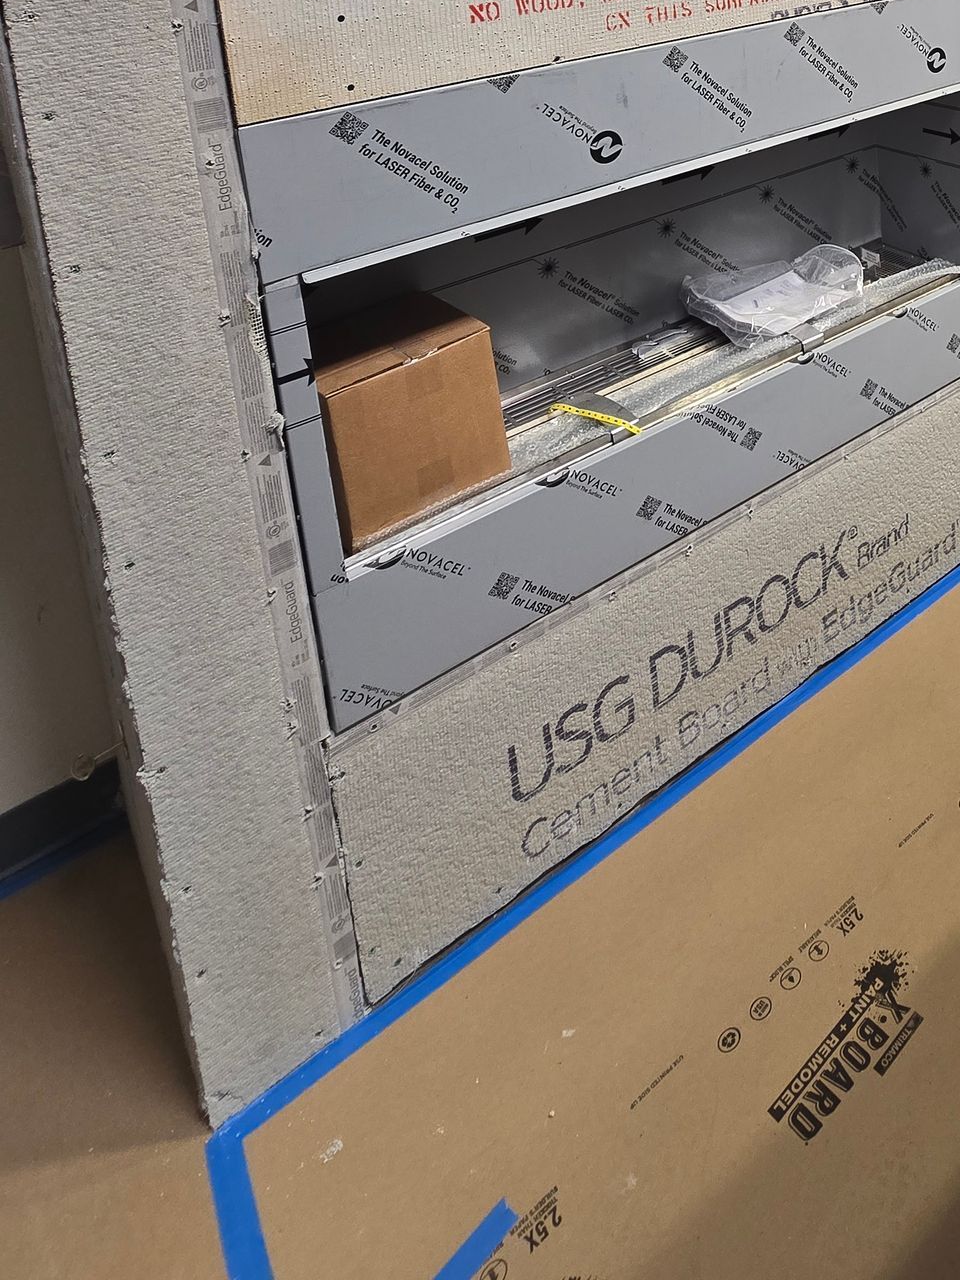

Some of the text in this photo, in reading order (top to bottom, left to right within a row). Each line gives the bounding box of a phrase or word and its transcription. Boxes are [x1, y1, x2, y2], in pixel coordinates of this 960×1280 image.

[468, 1, 500, 24] NO
[646, 0, 693, 26] THIS
[899, 23, 930, 58] NOVACEL
[799, 46, 809, 58] for
[807, 52, 827, 75] LASER
[825, 70, 841, 87] Fiber
[806, 35, 859, 89] The Novacel Solution
[681, 72, 693, 86] for
[691, 80, 715, 104] LASER
[713, 98, 731, 117] Fiber
[729, 111, 736, 122] &
[689, 61, 752, 118] The Novacel Solution
[541, 103, 593, 145] NOVACEL
[358, 143, 376, 160] for
[374, 152, 410, 180] LASER
[408, 172, 435, 195] Fiber
[434, 188, 444, 200] &
[371, 129, 469, 195] The Novacel Solution
[680, 231, 691, 242] The
[558, 279, 568, 288] for
[567, 285, 588, 299] LASER
[605, 305, 624, 320] LASER
[564, 270, 578, 282] The
[614, 298, 640, 317] Solution
[909, 308, 938, 332] NOVACEL
[816, 352, 849, 377] NOVACEL
[872, 397, 881, 408] for
[878, 386, 909, 409] The Novacel
[714, 405, 738, 423] LASER
[735, 417, 747, 431] for
[701, 417, 739, 443] The Novacel
[569, 469, 619, 497] NOVACEL
[654, 516, 689, 536] for LASER
[663, 503, 703, 527] The Novacel
[406, 548, 466, 577] NOVACEL
[419, 565, 428, 574] The
[510, 594, 552, 615] for LASER
[521, 579, 570, 605] The Novacel
[508, 675, 636, 803] USG
[856, 513, 911, 573] Brand
[521, 736, 672, 858] Cement
[679, 653, 772, 752] Board
[836, 908, 864, 938] 2.5X
[773, 977, 884, 1114] PAINT + REMODEL
[880, 1027, 912, 1068] TRIMACO
[629, 1054, 685, 1110] USE PRINTED SIDE UP
[509, 1214, 529, 1236] PAPER
[524, 1205, 562, 1255] 2.5X
